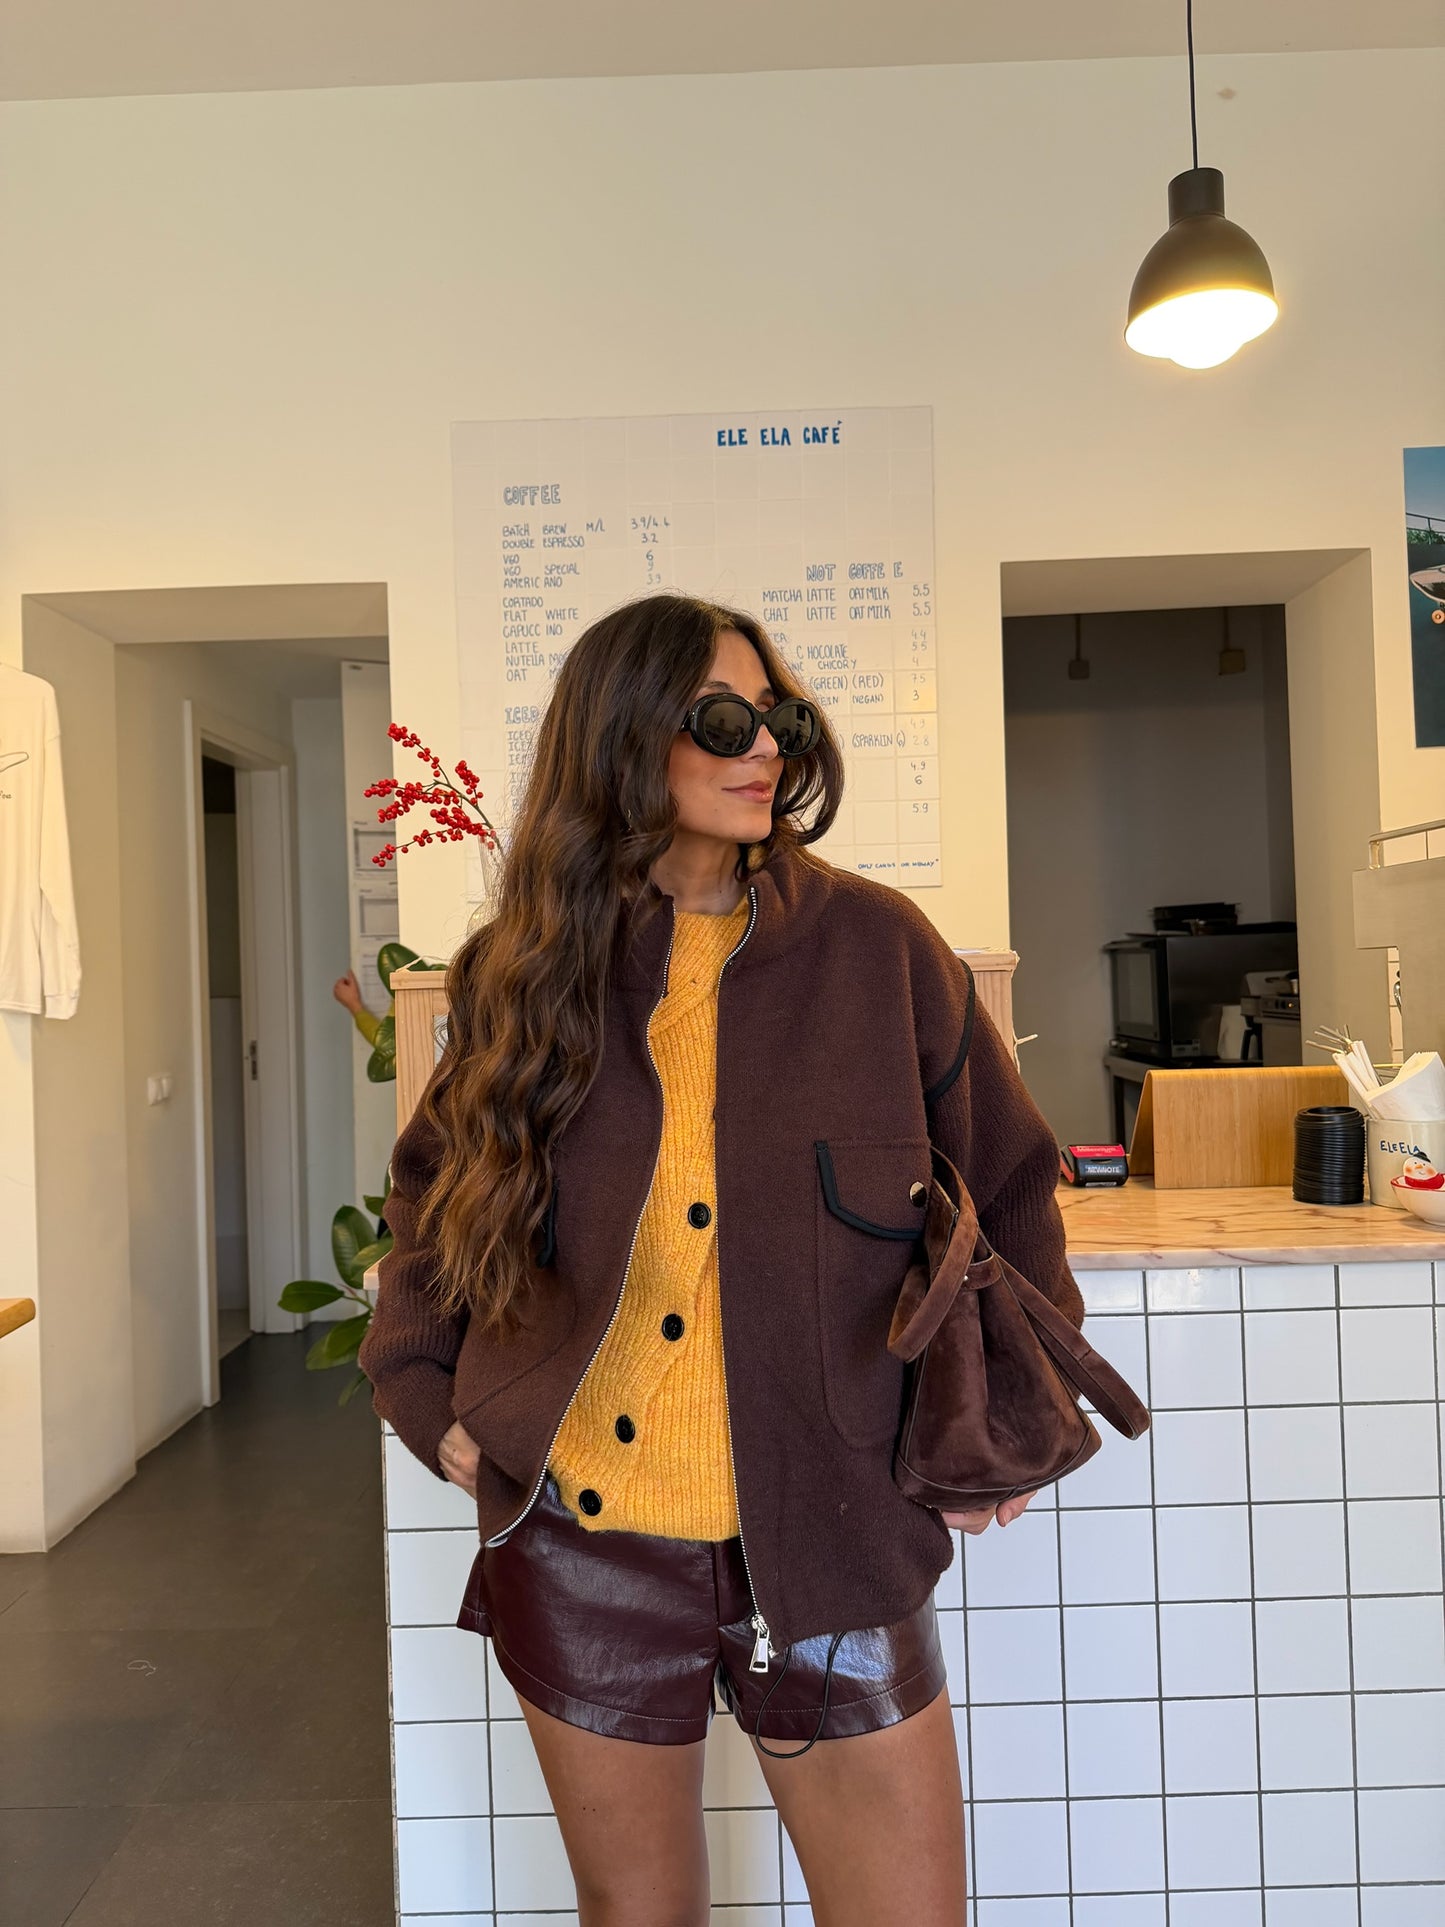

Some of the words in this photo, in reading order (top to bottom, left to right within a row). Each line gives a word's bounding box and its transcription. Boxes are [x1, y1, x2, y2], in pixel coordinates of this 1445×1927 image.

[717, 428, 748, 447] ELE
[760, 427, 791, 446] ELA
[803, 420, 842, 445] CAFÉ
[503, 484, 561, 506] COFFEE
[502, 523, 530, 537] BATCH
[542, 523, 567, 535] BREW
[585, 517, 605, 532] M/L
[502, 539, 535, 549] DOUBLE
[543, 535, 585, 548] ESPRESSO
[646, 550, 654, 561] 6
[544, 562, 580, 575] SPECIAL
[806, 564, 836, 581] NOT
[762, 589, 802, 603] MATCHA
[806, 588, 836, 601] LATTE
[913, 584, 930, 597] 5.5
[502, 597, 544, 608] CORTADO
[503, 610, 527, 621] FLAT
[545, 608, 579, 620] WHITE
[763, 607, 788, 621] CHAI
[806, 606, 836, 620] LATTE
[913, 602, 931, 616] 5.5
[505, 641, 539, 654] LATTE
[505, 653, 545, 667] NUTELLA
[506, 668, 527, 681] OAT
[809, 675, 848, 691] (GREEN)
[852, 672, 884, 689] (RED)
[913, 691, 920, 701] 3
[914, 775, 923, 785] 6
